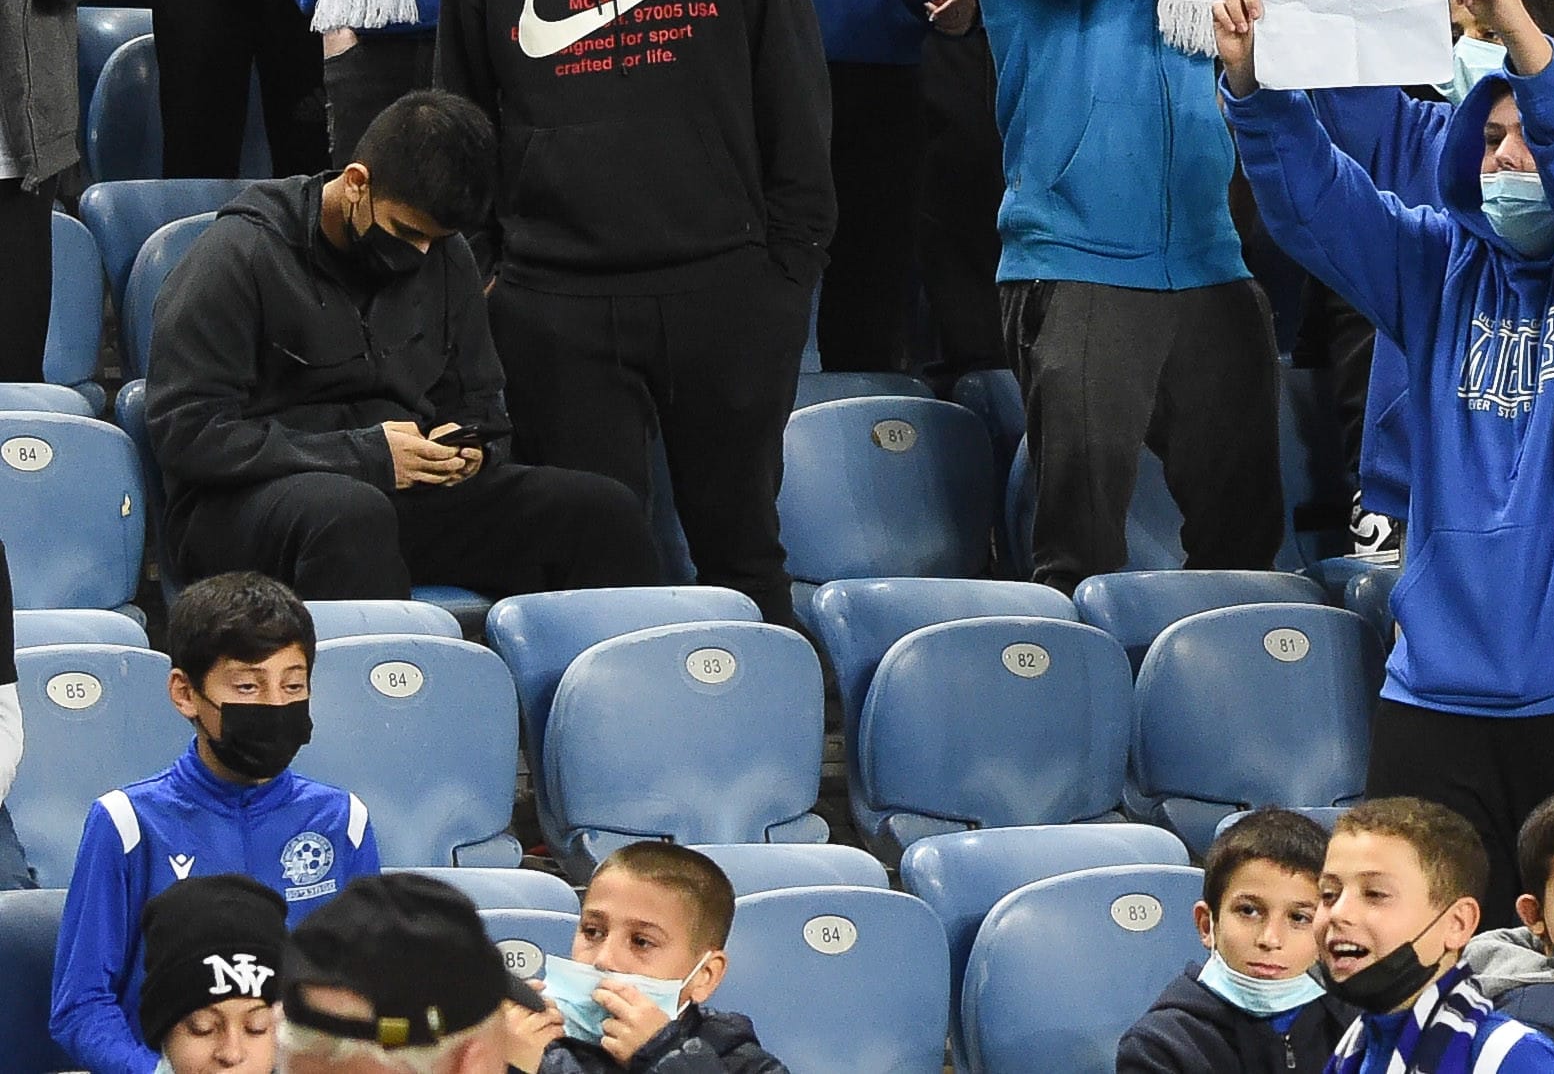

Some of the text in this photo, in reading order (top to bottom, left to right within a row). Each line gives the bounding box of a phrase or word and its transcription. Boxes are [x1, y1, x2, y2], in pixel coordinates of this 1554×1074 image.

[633, 5, 683, 23] 97005
[688, 2, 719, 17] USA
[649, 24, 693, 43] sport
[555, 56, 612, 77] crafted
[646, 49, 677, 64] life.
[1497, 406, 1518, 419] STO
[19, 446, 37, 462] 84
[1280, 638, 1296, 653] 81
[703, 658, 721, 674] 83
[1017, 653, 1036, 668] 82
[388, 672, 408, 688] 84
[65, 683, 86, 699] 85
[1129, 904, 1147, 921] 83
[822, 926, 841, 943] 84
[506, 951, 526, 969] 85
